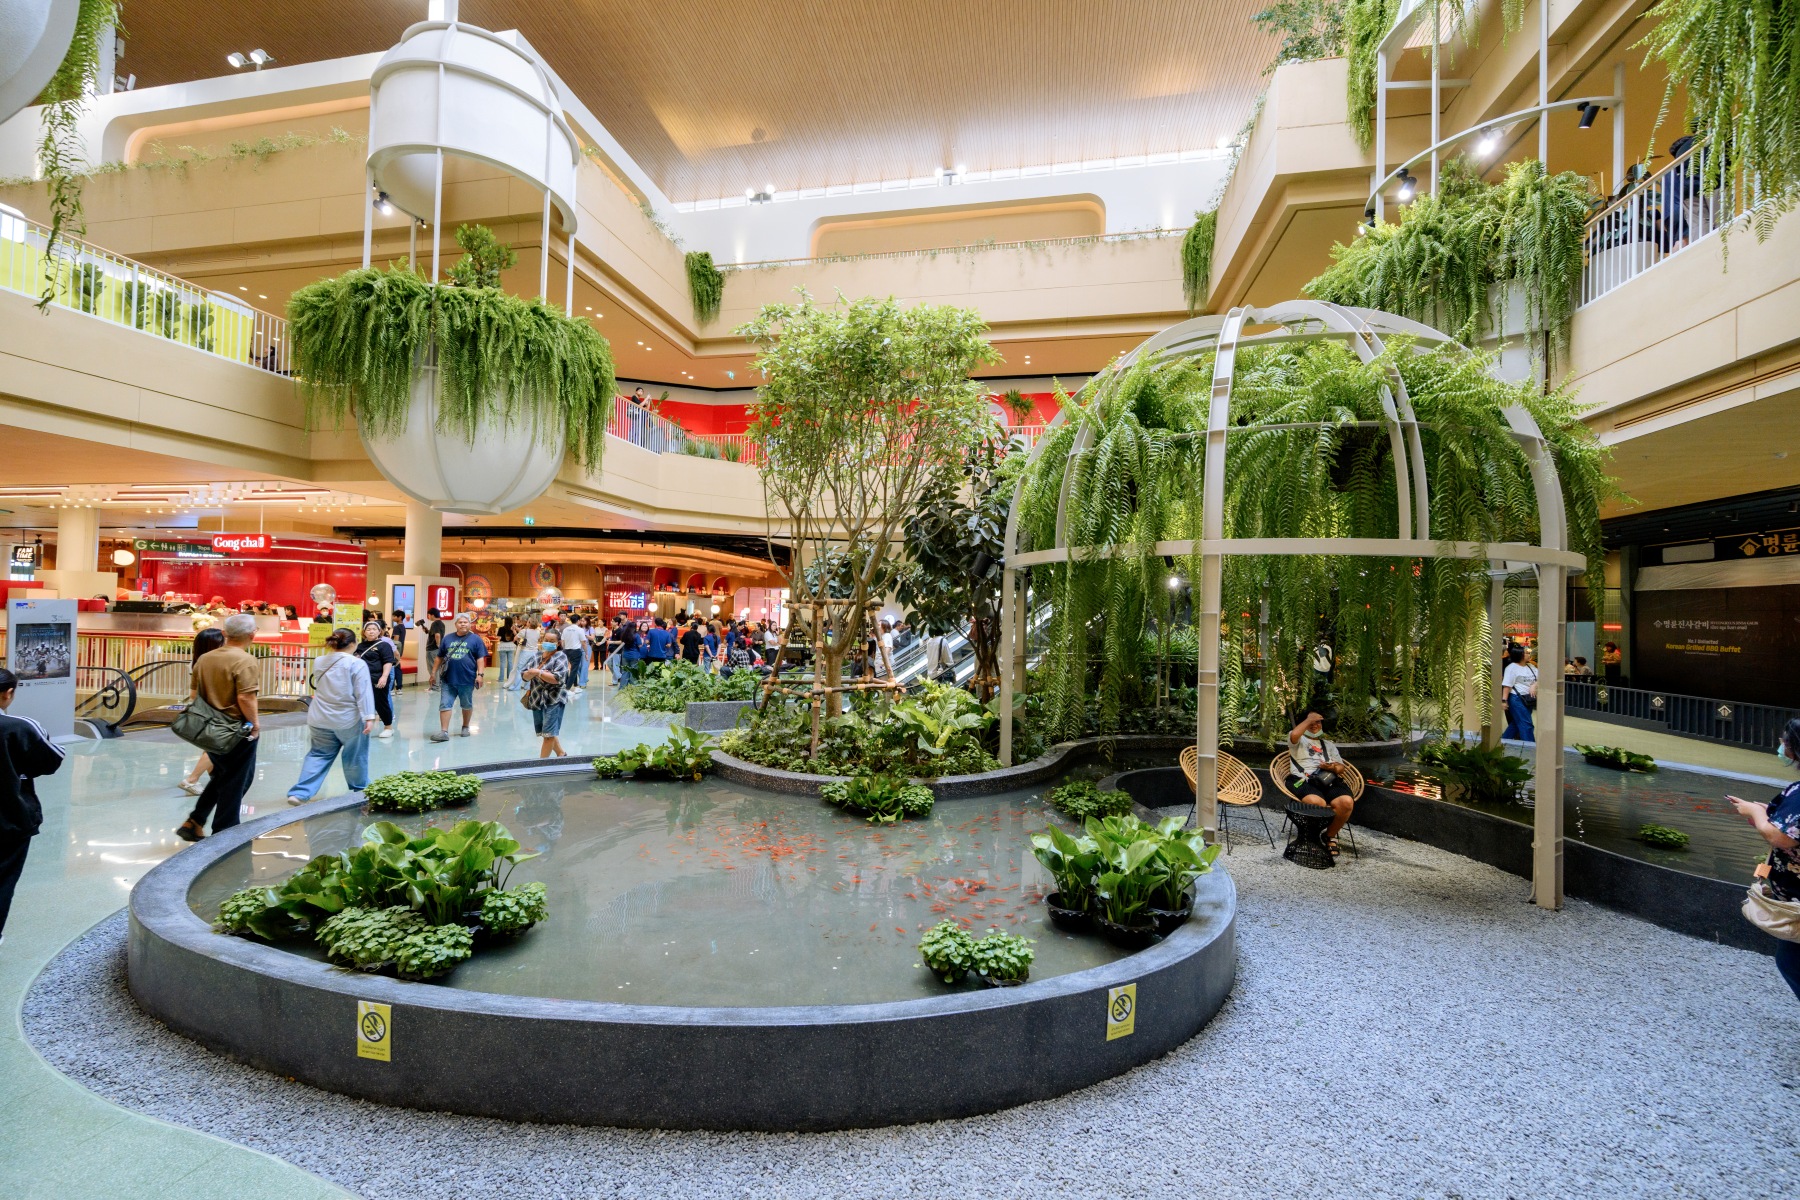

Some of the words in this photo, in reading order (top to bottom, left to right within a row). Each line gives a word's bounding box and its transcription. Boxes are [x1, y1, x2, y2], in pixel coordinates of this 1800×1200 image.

[135, 540, 148, 550] G
[214, 536, 240, 551] Gong
[240, 537, 258, 548] cha
[1720, 645, 1741, 653] Buffet
